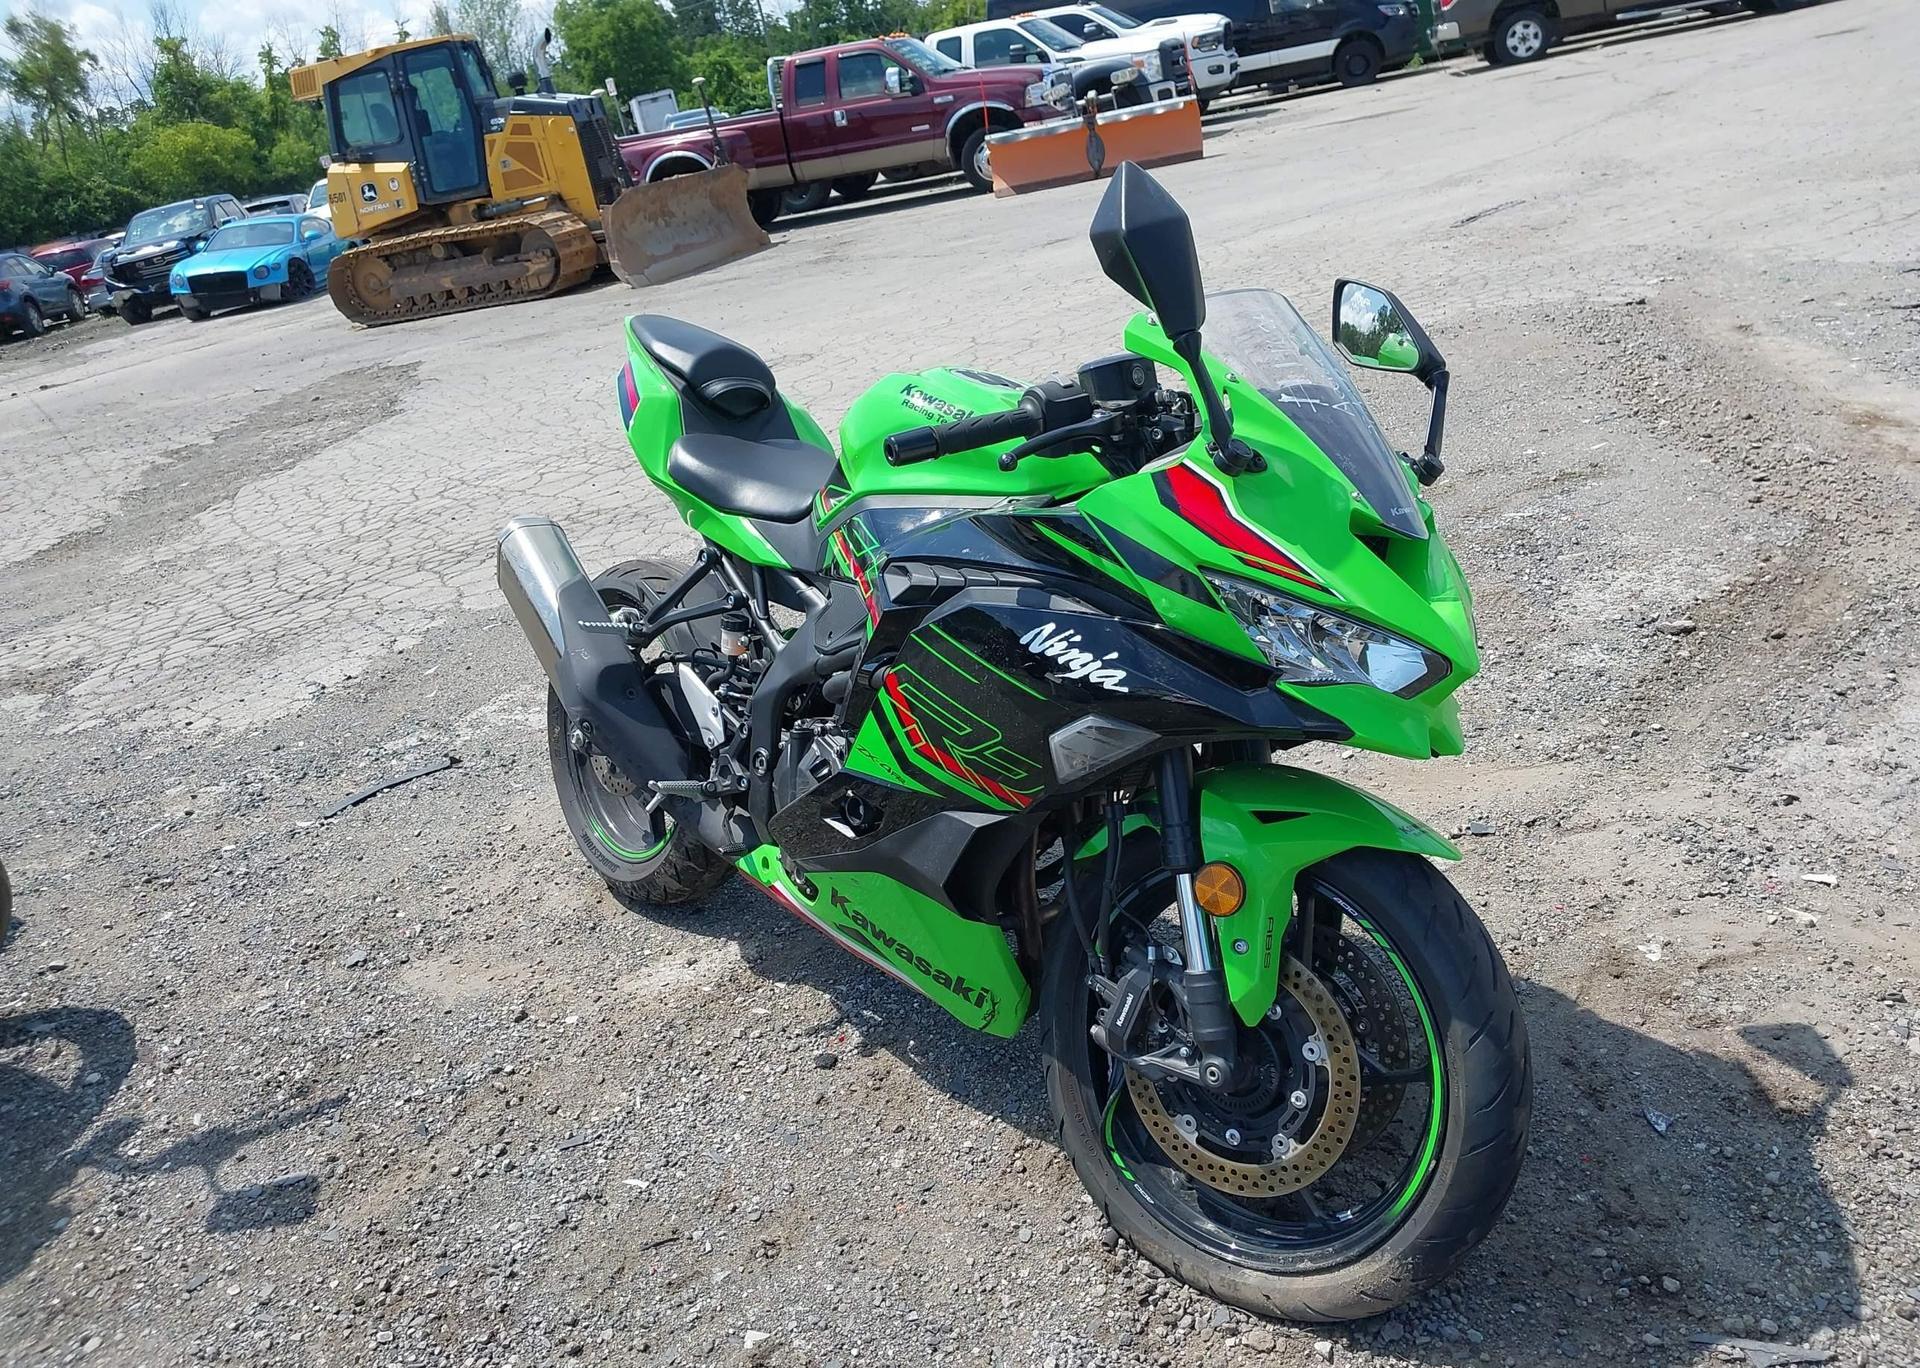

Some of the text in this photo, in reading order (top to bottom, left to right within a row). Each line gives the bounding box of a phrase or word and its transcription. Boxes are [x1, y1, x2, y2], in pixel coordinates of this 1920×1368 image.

[901, 398, 935, 420] Racing
[1020, 622, 1129, 693] Ninja
[831, 886, 992, 1009] Kawasaki
[1263, 916, 1275, 969] ABS
[1115, 992, 1135, 1028] Kawasaki
